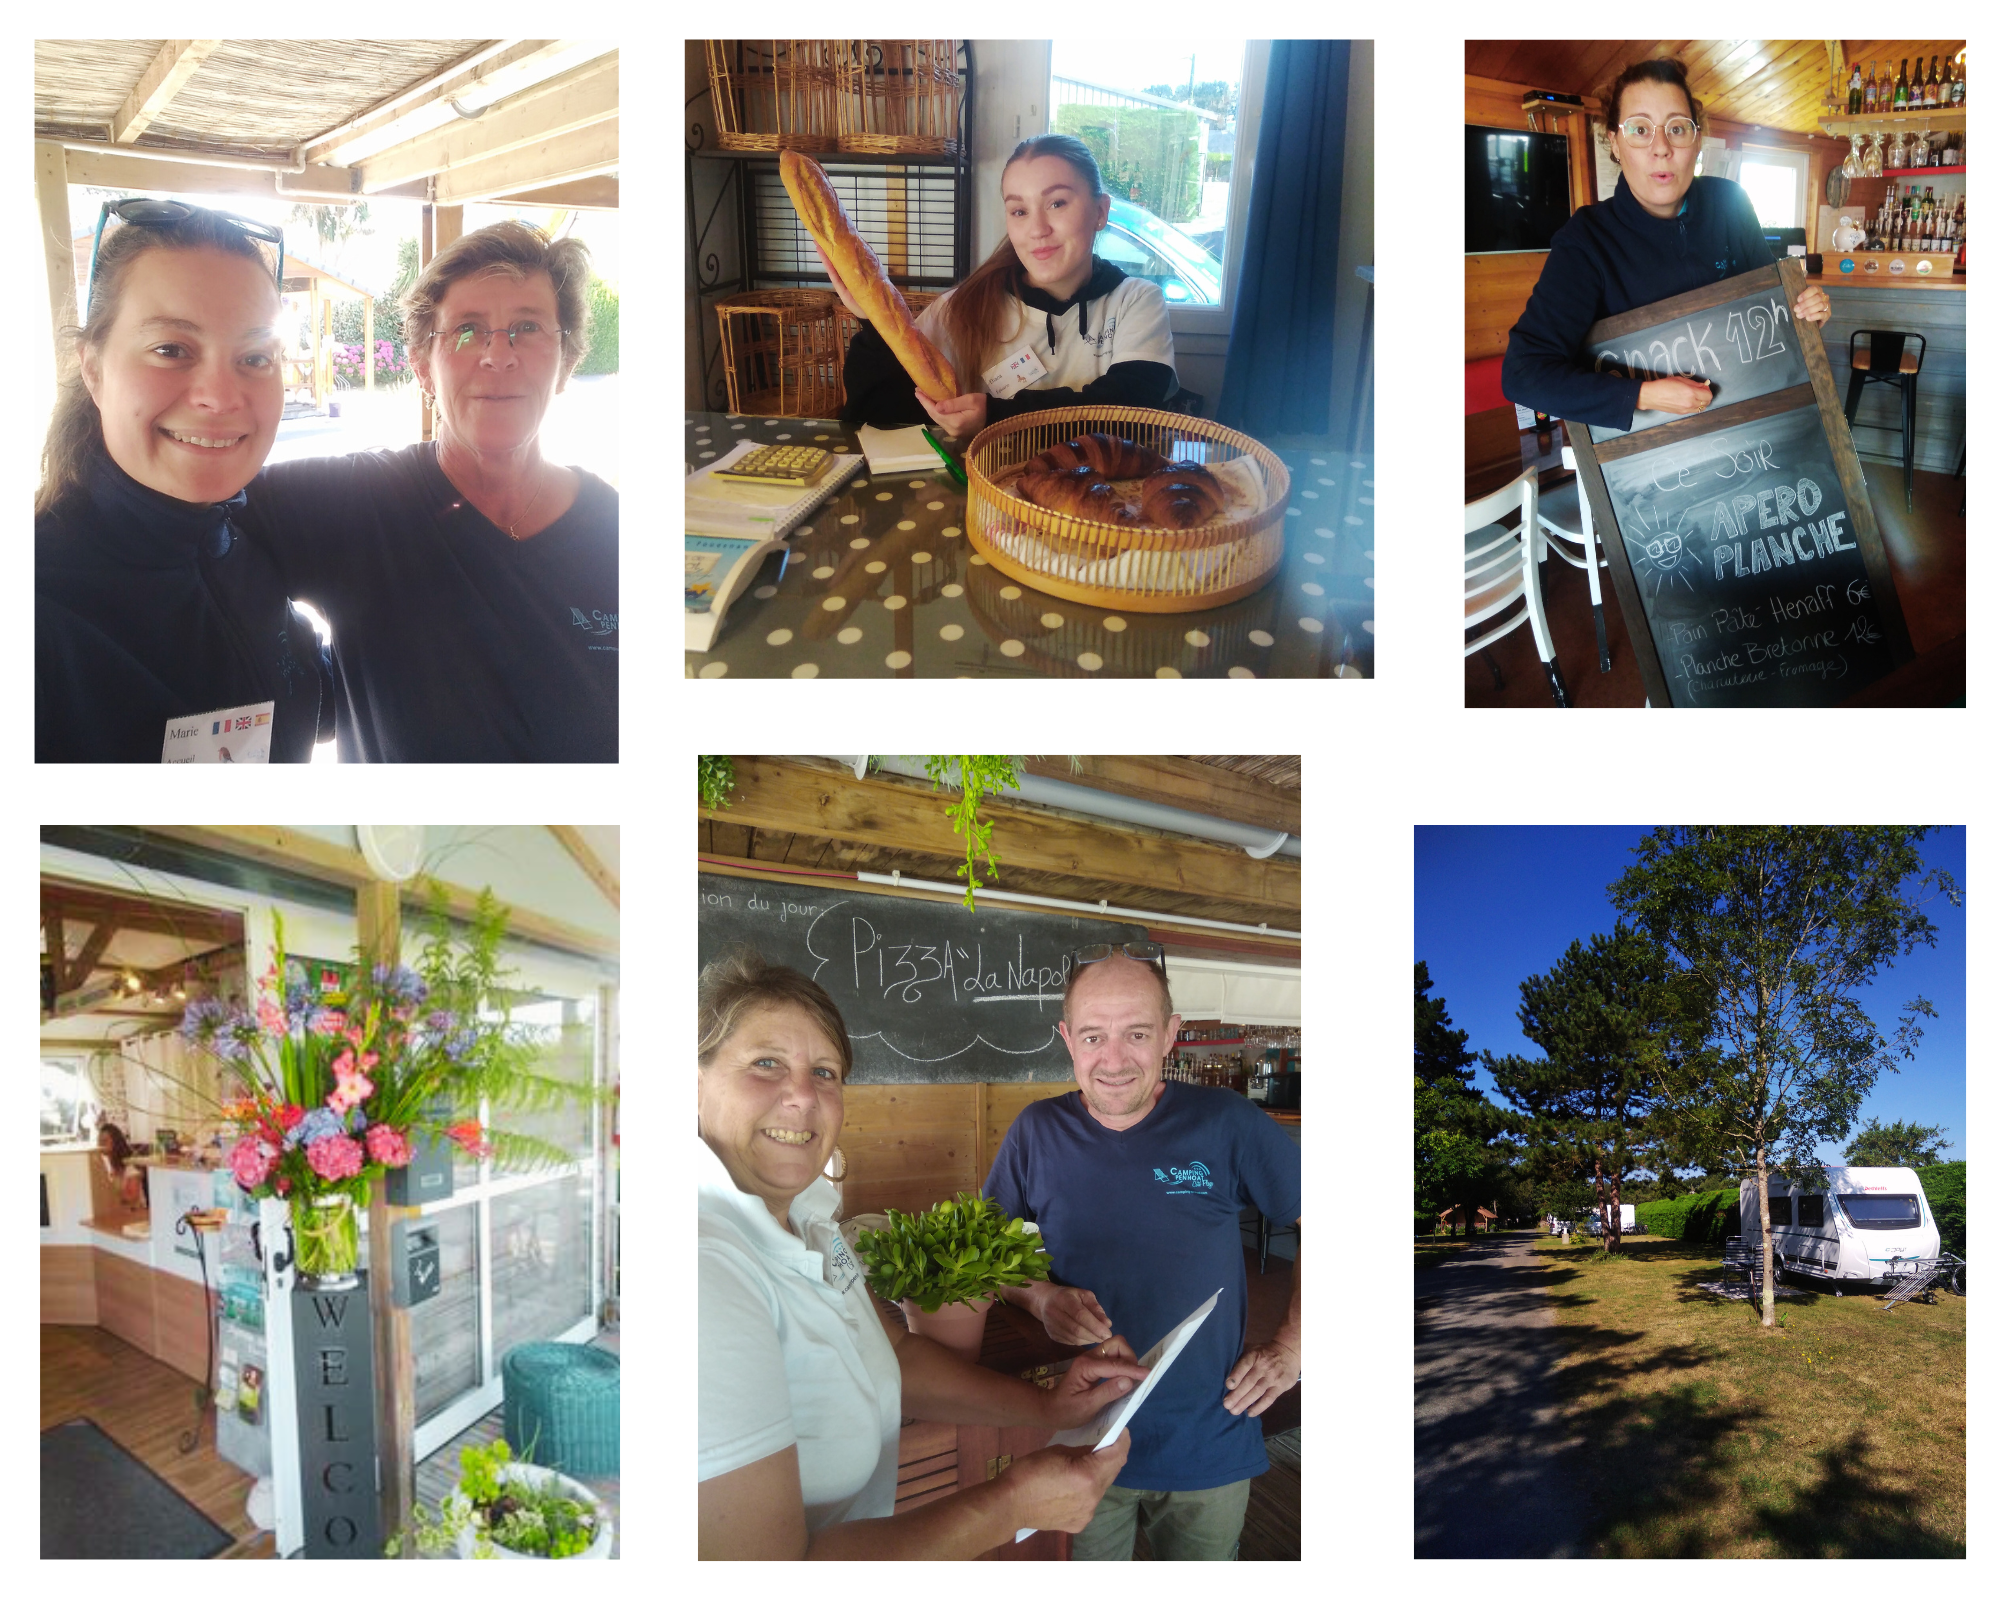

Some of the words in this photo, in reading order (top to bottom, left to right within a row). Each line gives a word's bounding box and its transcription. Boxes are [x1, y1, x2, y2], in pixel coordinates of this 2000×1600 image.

[1726, 298, 1789, 363] 12h
[1651, 457, 1698, 492] Ce
[1710, 478, 1823, 541] APERO
[1713, 510, 1857, 580] PLANCHE
[592, 609, 619, 621] CAM
[601, 620, 619, 630] PEN
[1742, 630, 1840, 664] Bretonne
[169, 726, 199, 740] Marie
[747, 892, 770, 910] du
